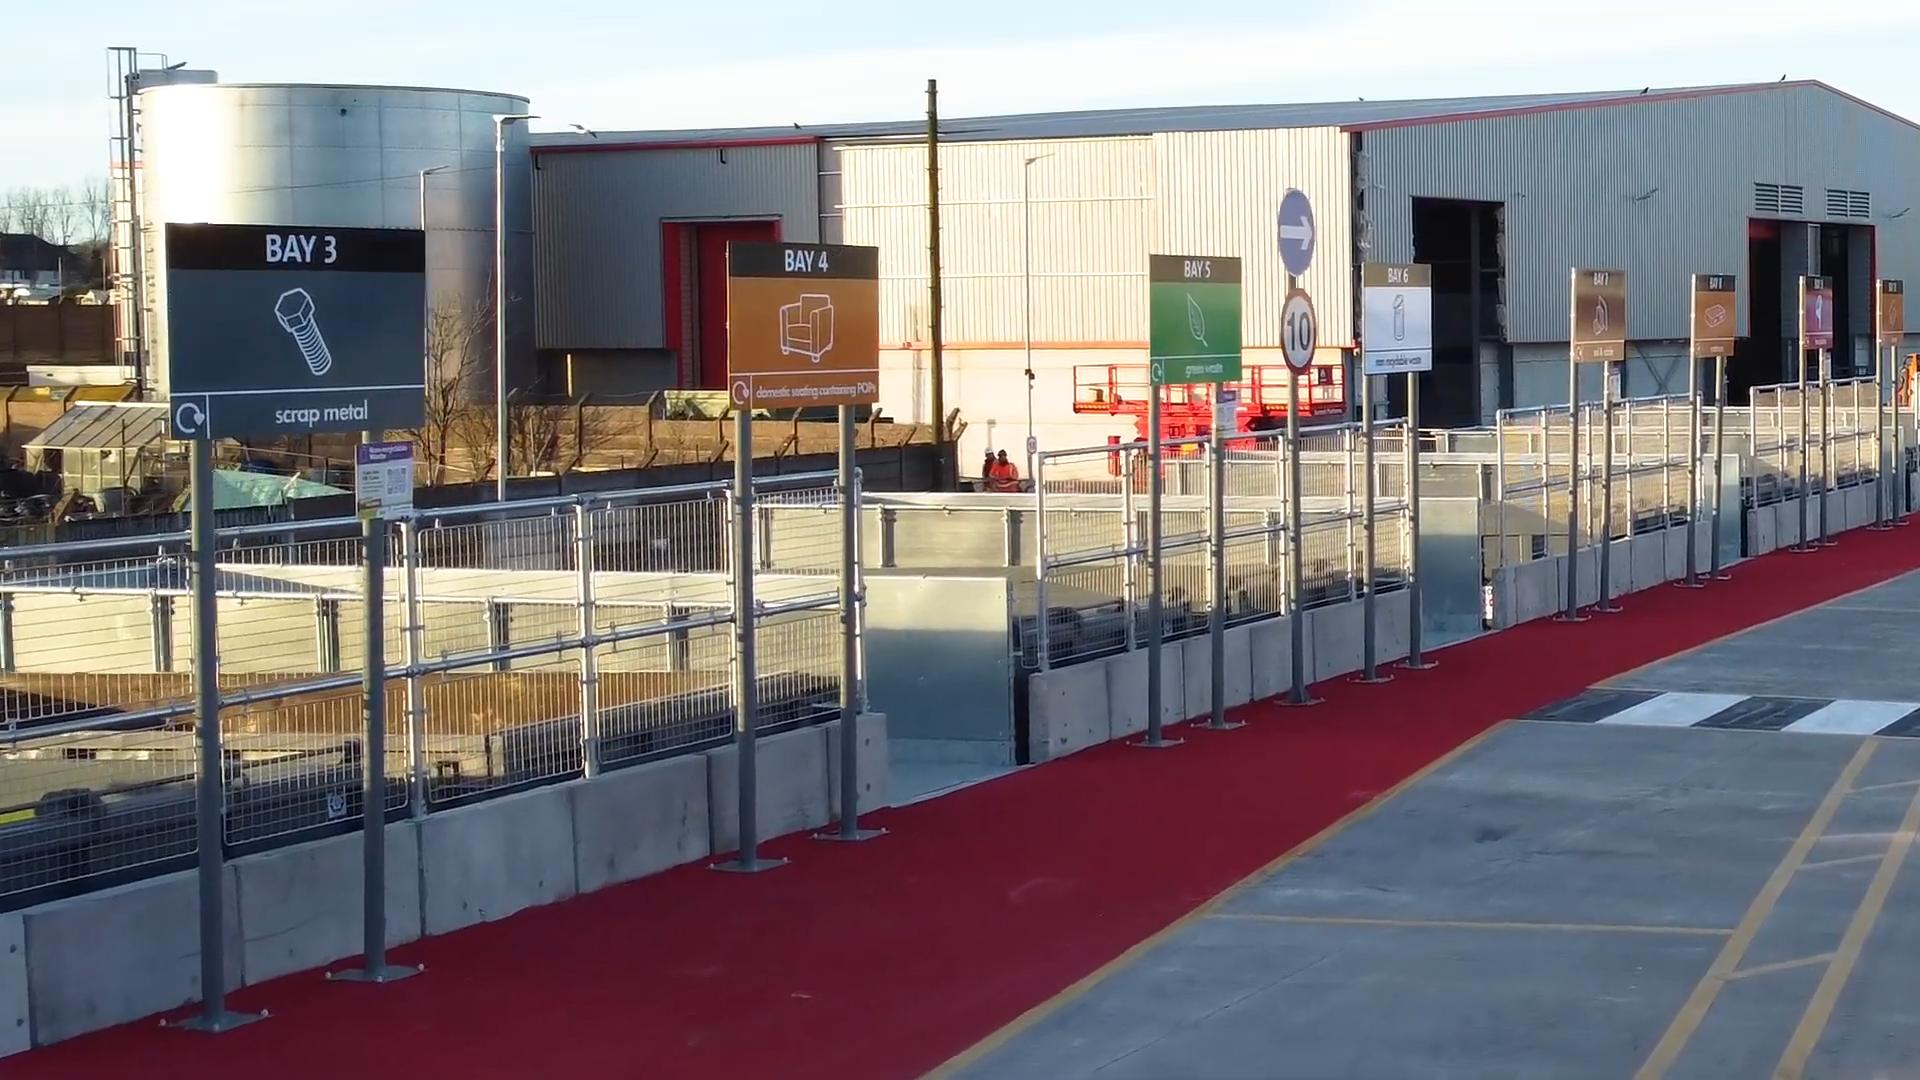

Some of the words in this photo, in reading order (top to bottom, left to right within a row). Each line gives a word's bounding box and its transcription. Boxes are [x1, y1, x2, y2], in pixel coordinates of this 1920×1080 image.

[266, 234, 317, 263] BAY
[324, 235, 337, 264] 3
[785, 249, 815, 272] BAY
[818, 251, 828, 272] 4
[1184, 260, 1204, 278] BAY
[1205, 261, 1211, 278] 5
[1388, 267, 1403, 283] BAY
[1403, 267, 1409, 283] 6
[1287, 311, 1311, 351] 10
[275, 408, 320, 428] scrap
[324, 399, 368, 421] metal
